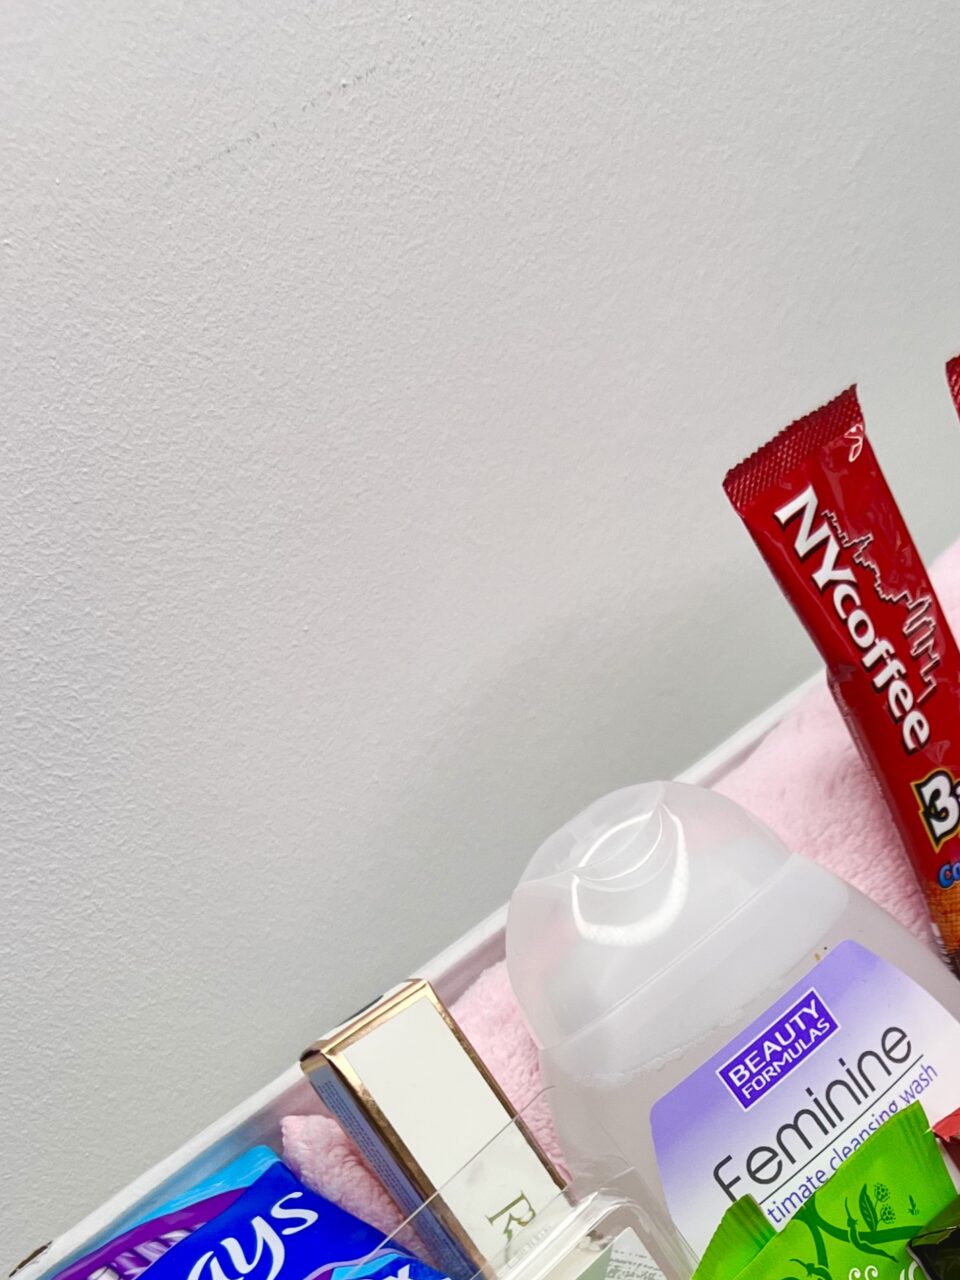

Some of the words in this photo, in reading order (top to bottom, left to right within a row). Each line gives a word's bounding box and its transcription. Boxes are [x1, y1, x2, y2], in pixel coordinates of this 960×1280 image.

[728, 999, 822, 1086] BEAUTY
[742, 1018, 830, 1099] FORMULAS
[900, 1063, 938, 1106] wash
[713, 1026, 912, 1202] Feminine
